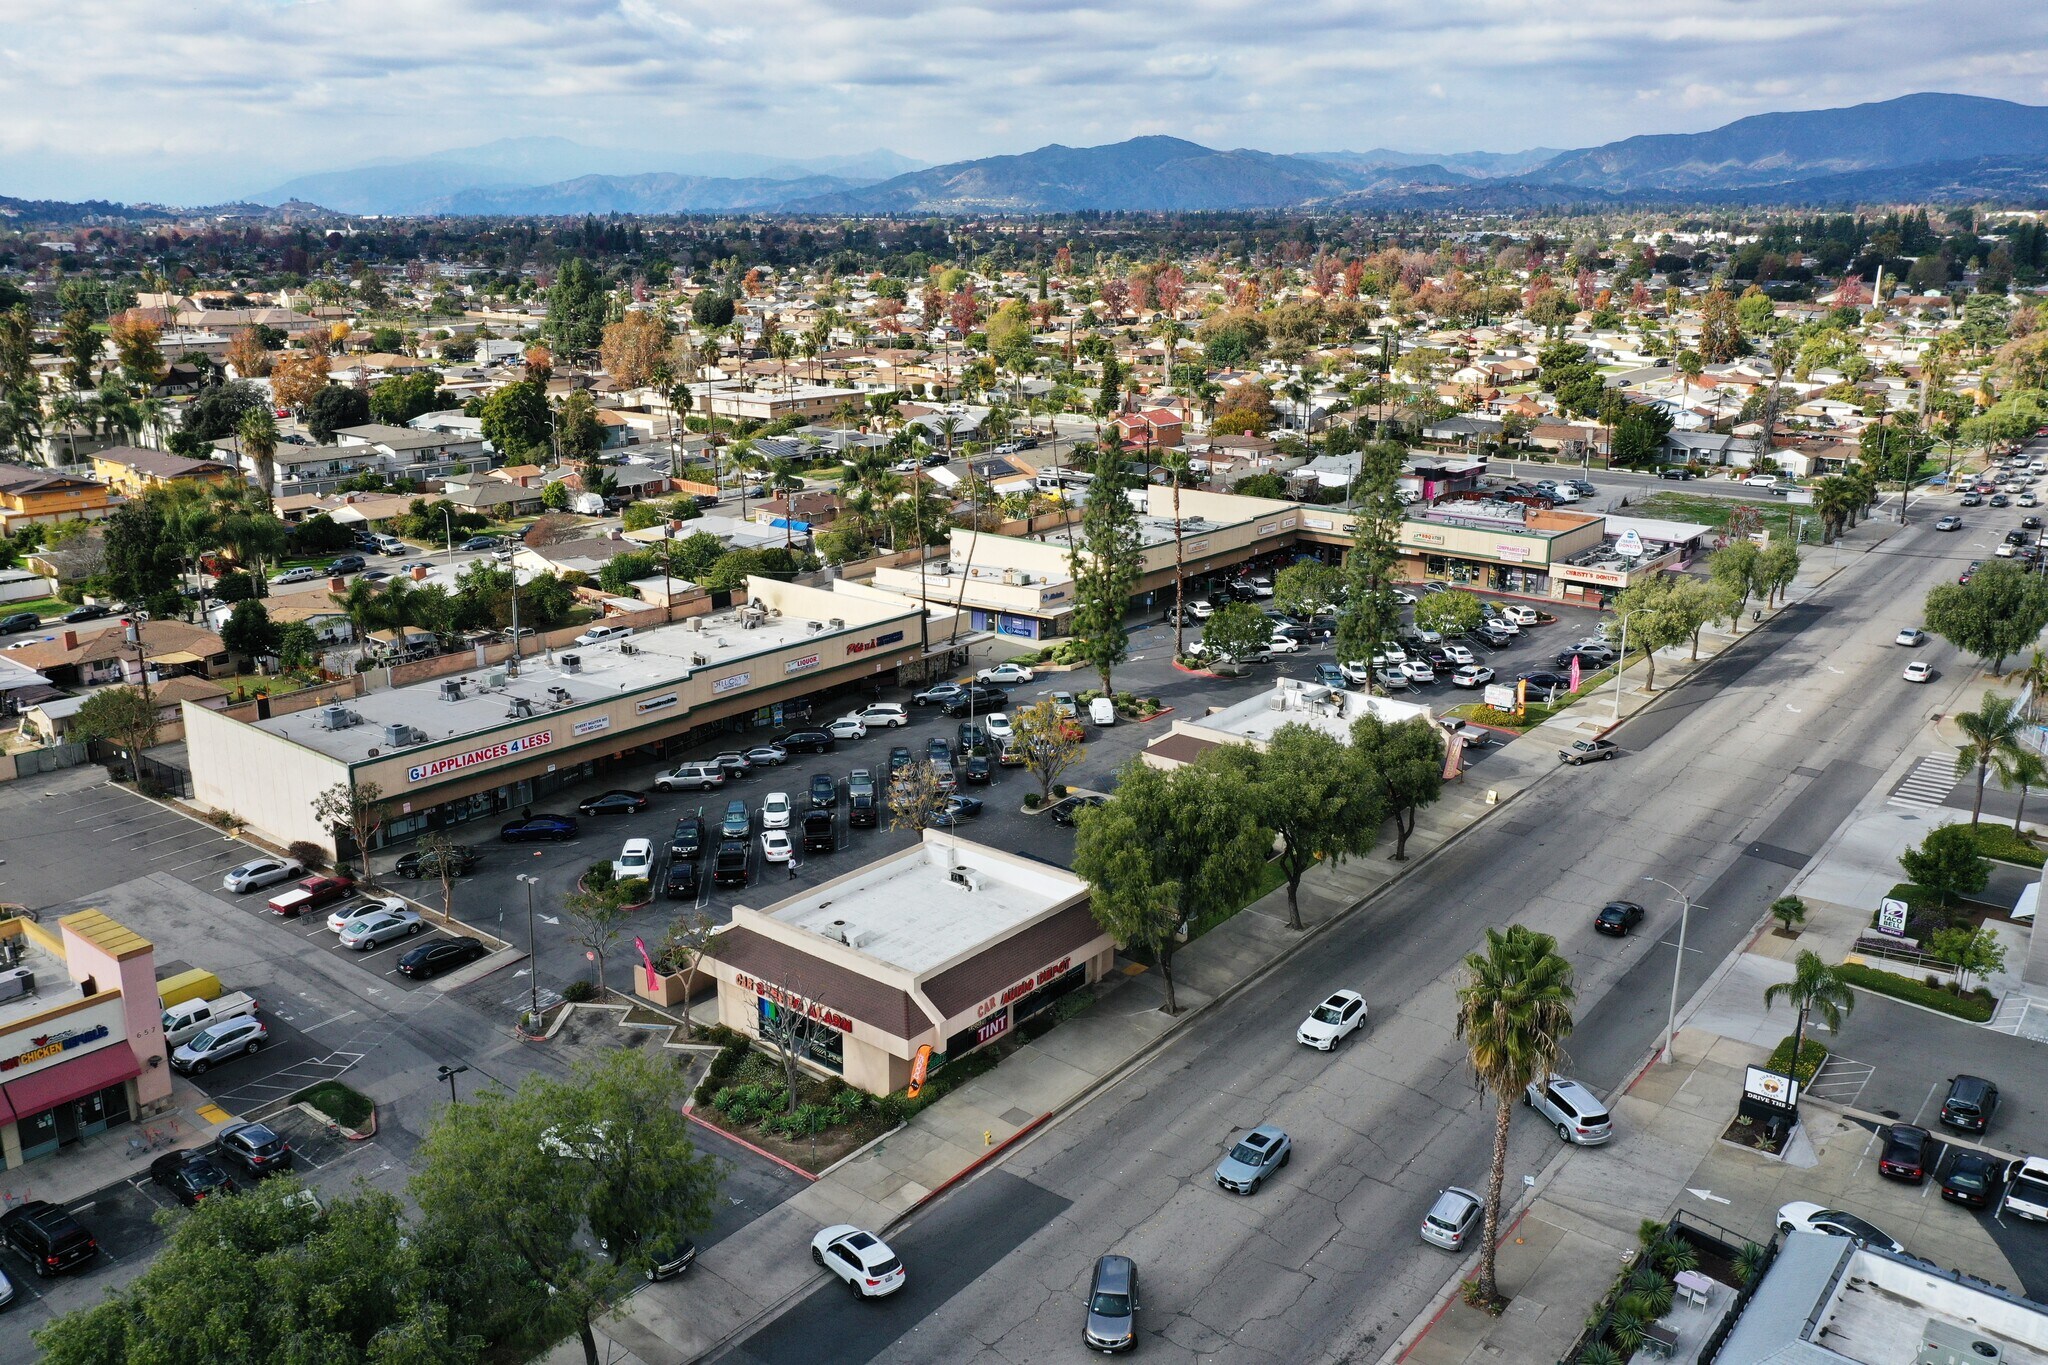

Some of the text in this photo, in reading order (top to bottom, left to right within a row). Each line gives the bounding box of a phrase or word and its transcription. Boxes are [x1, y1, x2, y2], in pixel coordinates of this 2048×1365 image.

[1595, 574, 1619, 582] DONUTS
[797, 656, 817, 667] LIQUOR
[410, 732, 550, 780] GJ APPLIANCES 4 LESS
[1883, 914, 1903, 924] TACO
[1883, 920, 1901, 929] BELL
[735, 973, 754, 991] CAR
[977, 957, 1071, 1018] CAR AUDIO DEPOT
[136, 1026, 156, 1039] 657
[978, 1015, 1007, 1042] TINT
[20, 1041, 63, 1065] CHICKEN
[1747, 1092, 1771, 1104] DRIVE
